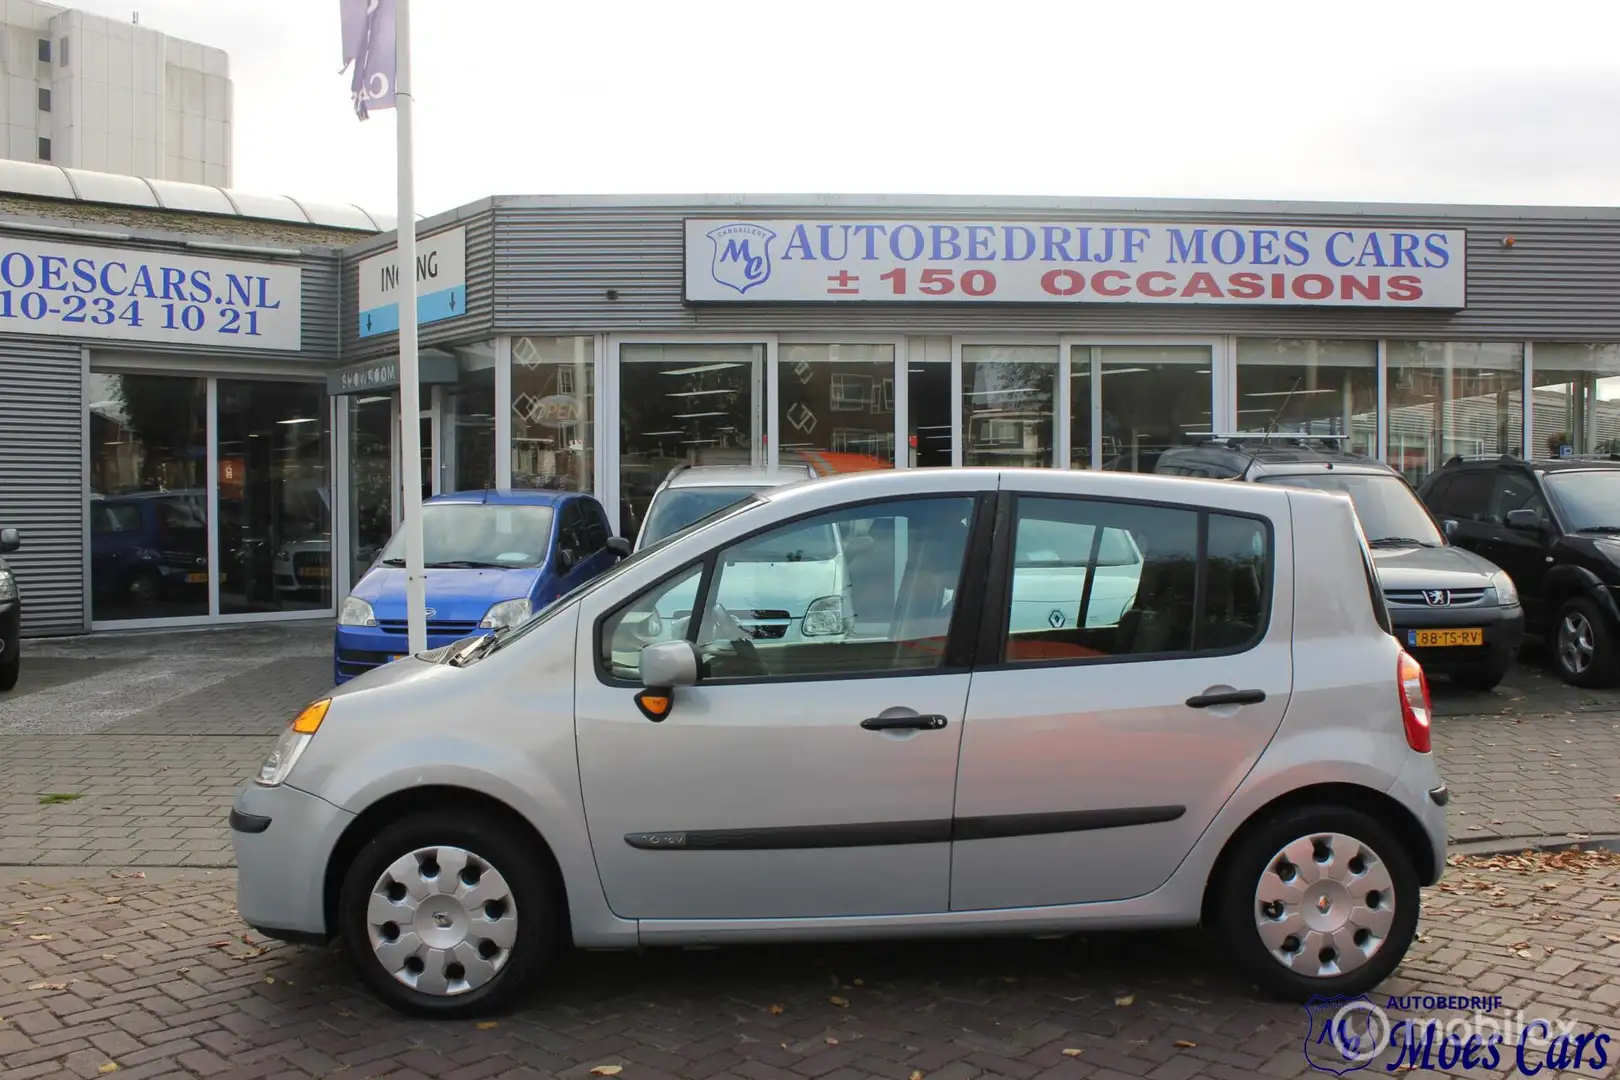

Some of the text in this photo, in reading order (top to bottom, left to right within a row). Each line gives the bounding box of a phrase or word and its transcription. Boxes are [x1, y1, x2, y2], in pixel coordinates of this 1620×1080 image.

[781, 223, 1450, 269] AUTOBEDRIJF MOES CARS
[0, 252, 281, 309] OESCARS.NL
[381, 251, 438, 293] INNG
[880, 268, 997, 296] 150
[1040, 269, 1424, 302] OCCASIONS
[0, 289, 262, 336] 10-234 10 21
[341, 365, 395, 389] SHOWROOM
[1420, 631, 1479, 645] 88-TS-RV
